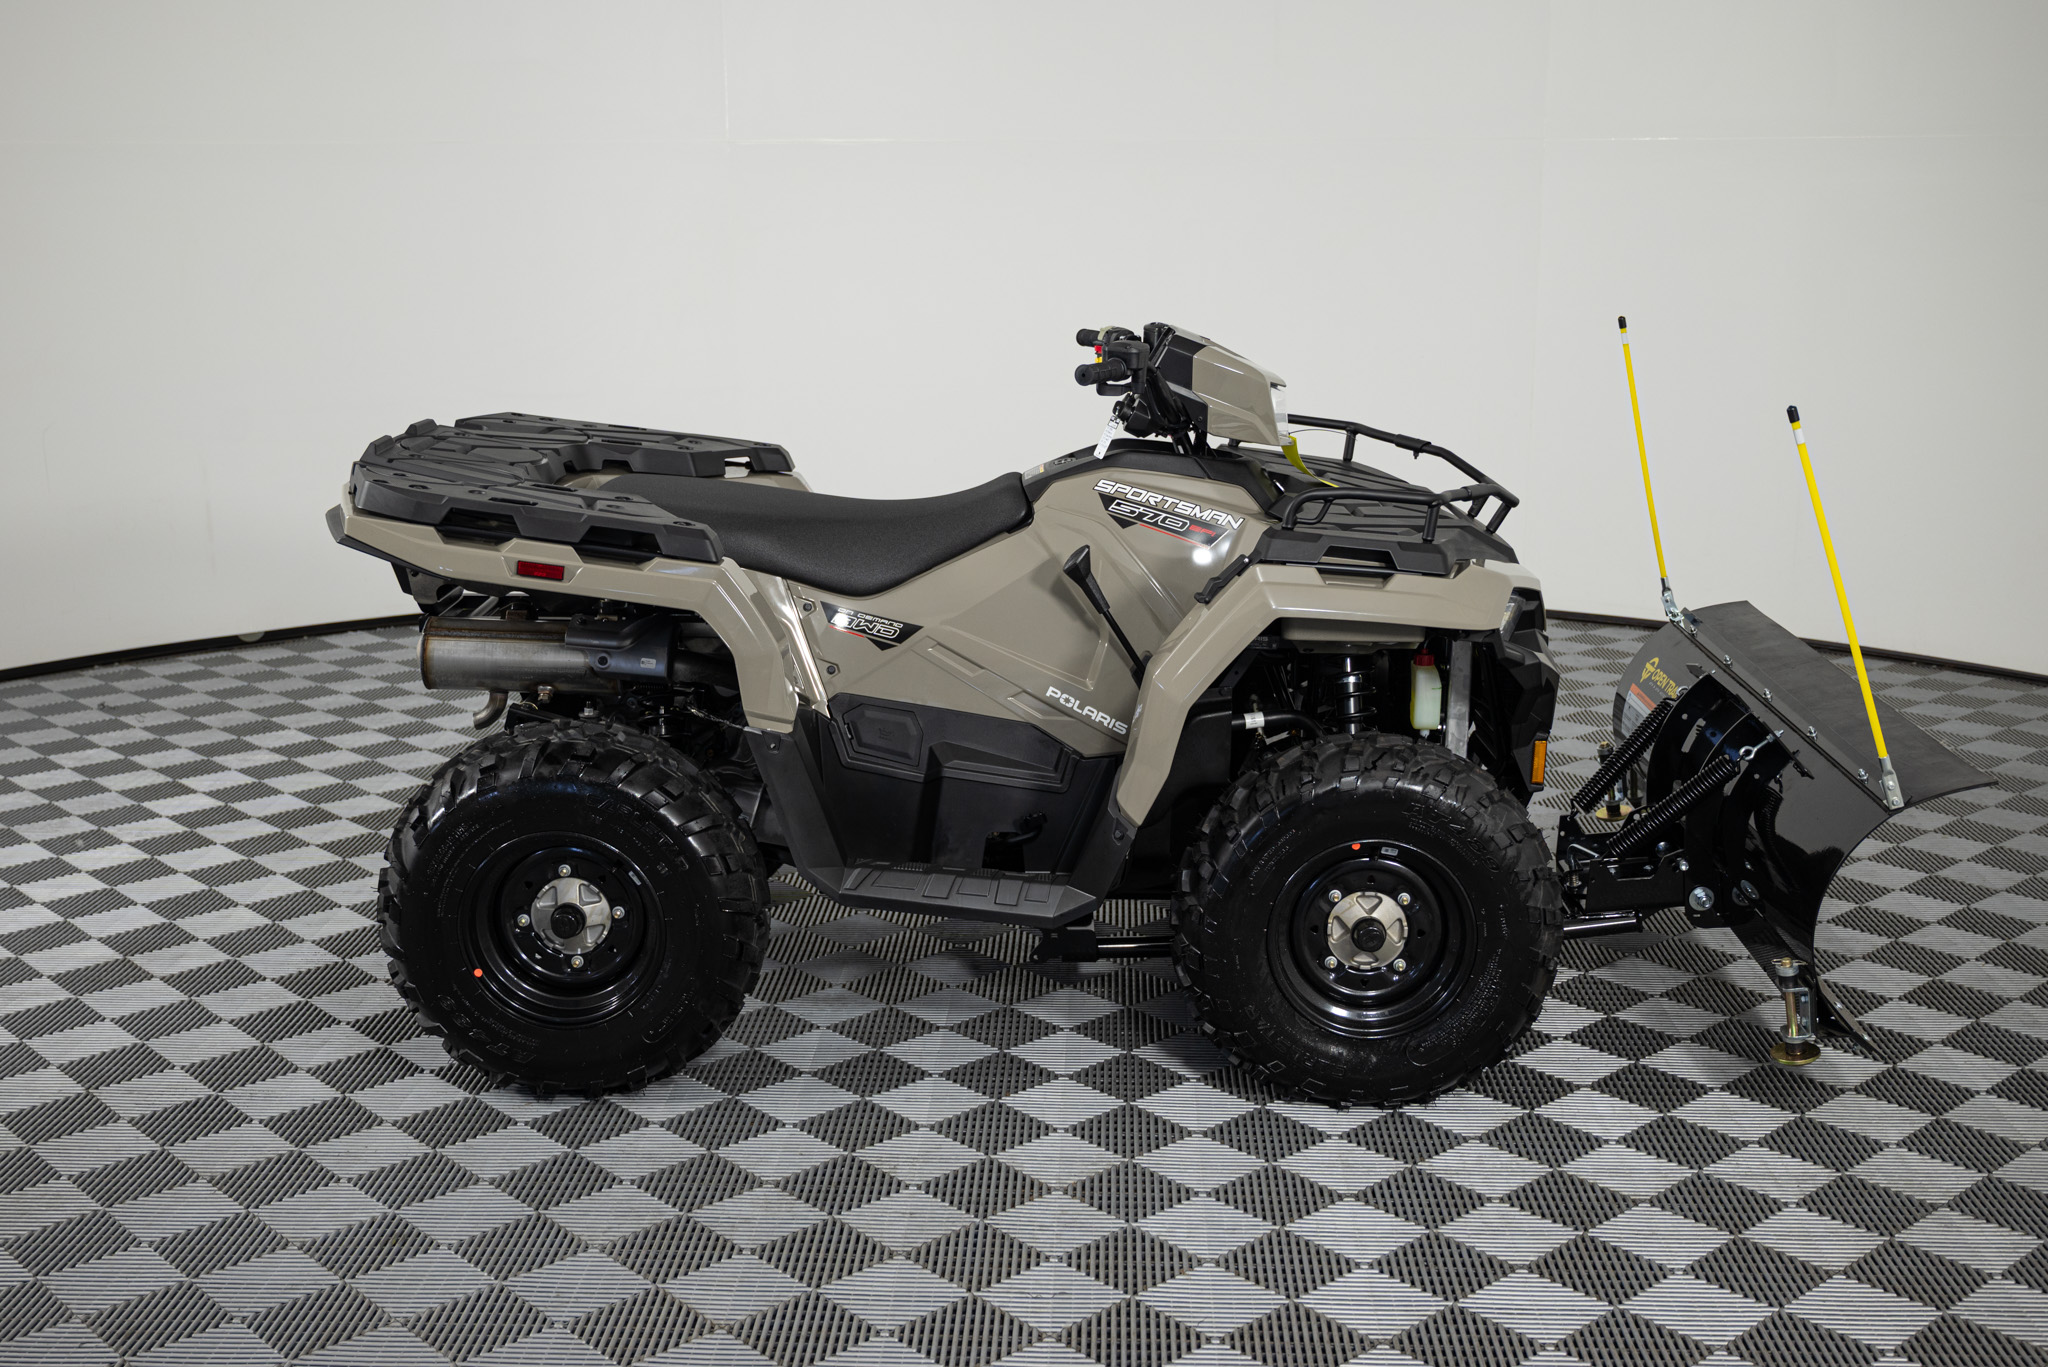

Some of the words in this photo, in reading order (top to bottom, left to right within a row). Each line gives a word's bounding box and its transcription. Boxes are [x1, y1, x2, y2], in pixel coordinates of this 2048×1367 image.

[1093, 479, 1245, 530] SPORTSMAN
[1108, 499, 1190, 532] 570
[1188, 524, 1216, 537] EFI
[838, 607, 854, 616] ON
[857, 612, 904, 629] DEMAND
[1651, 668, 1670, 689] OPEN
[1045, 685, 1129, 735] POLARIS
